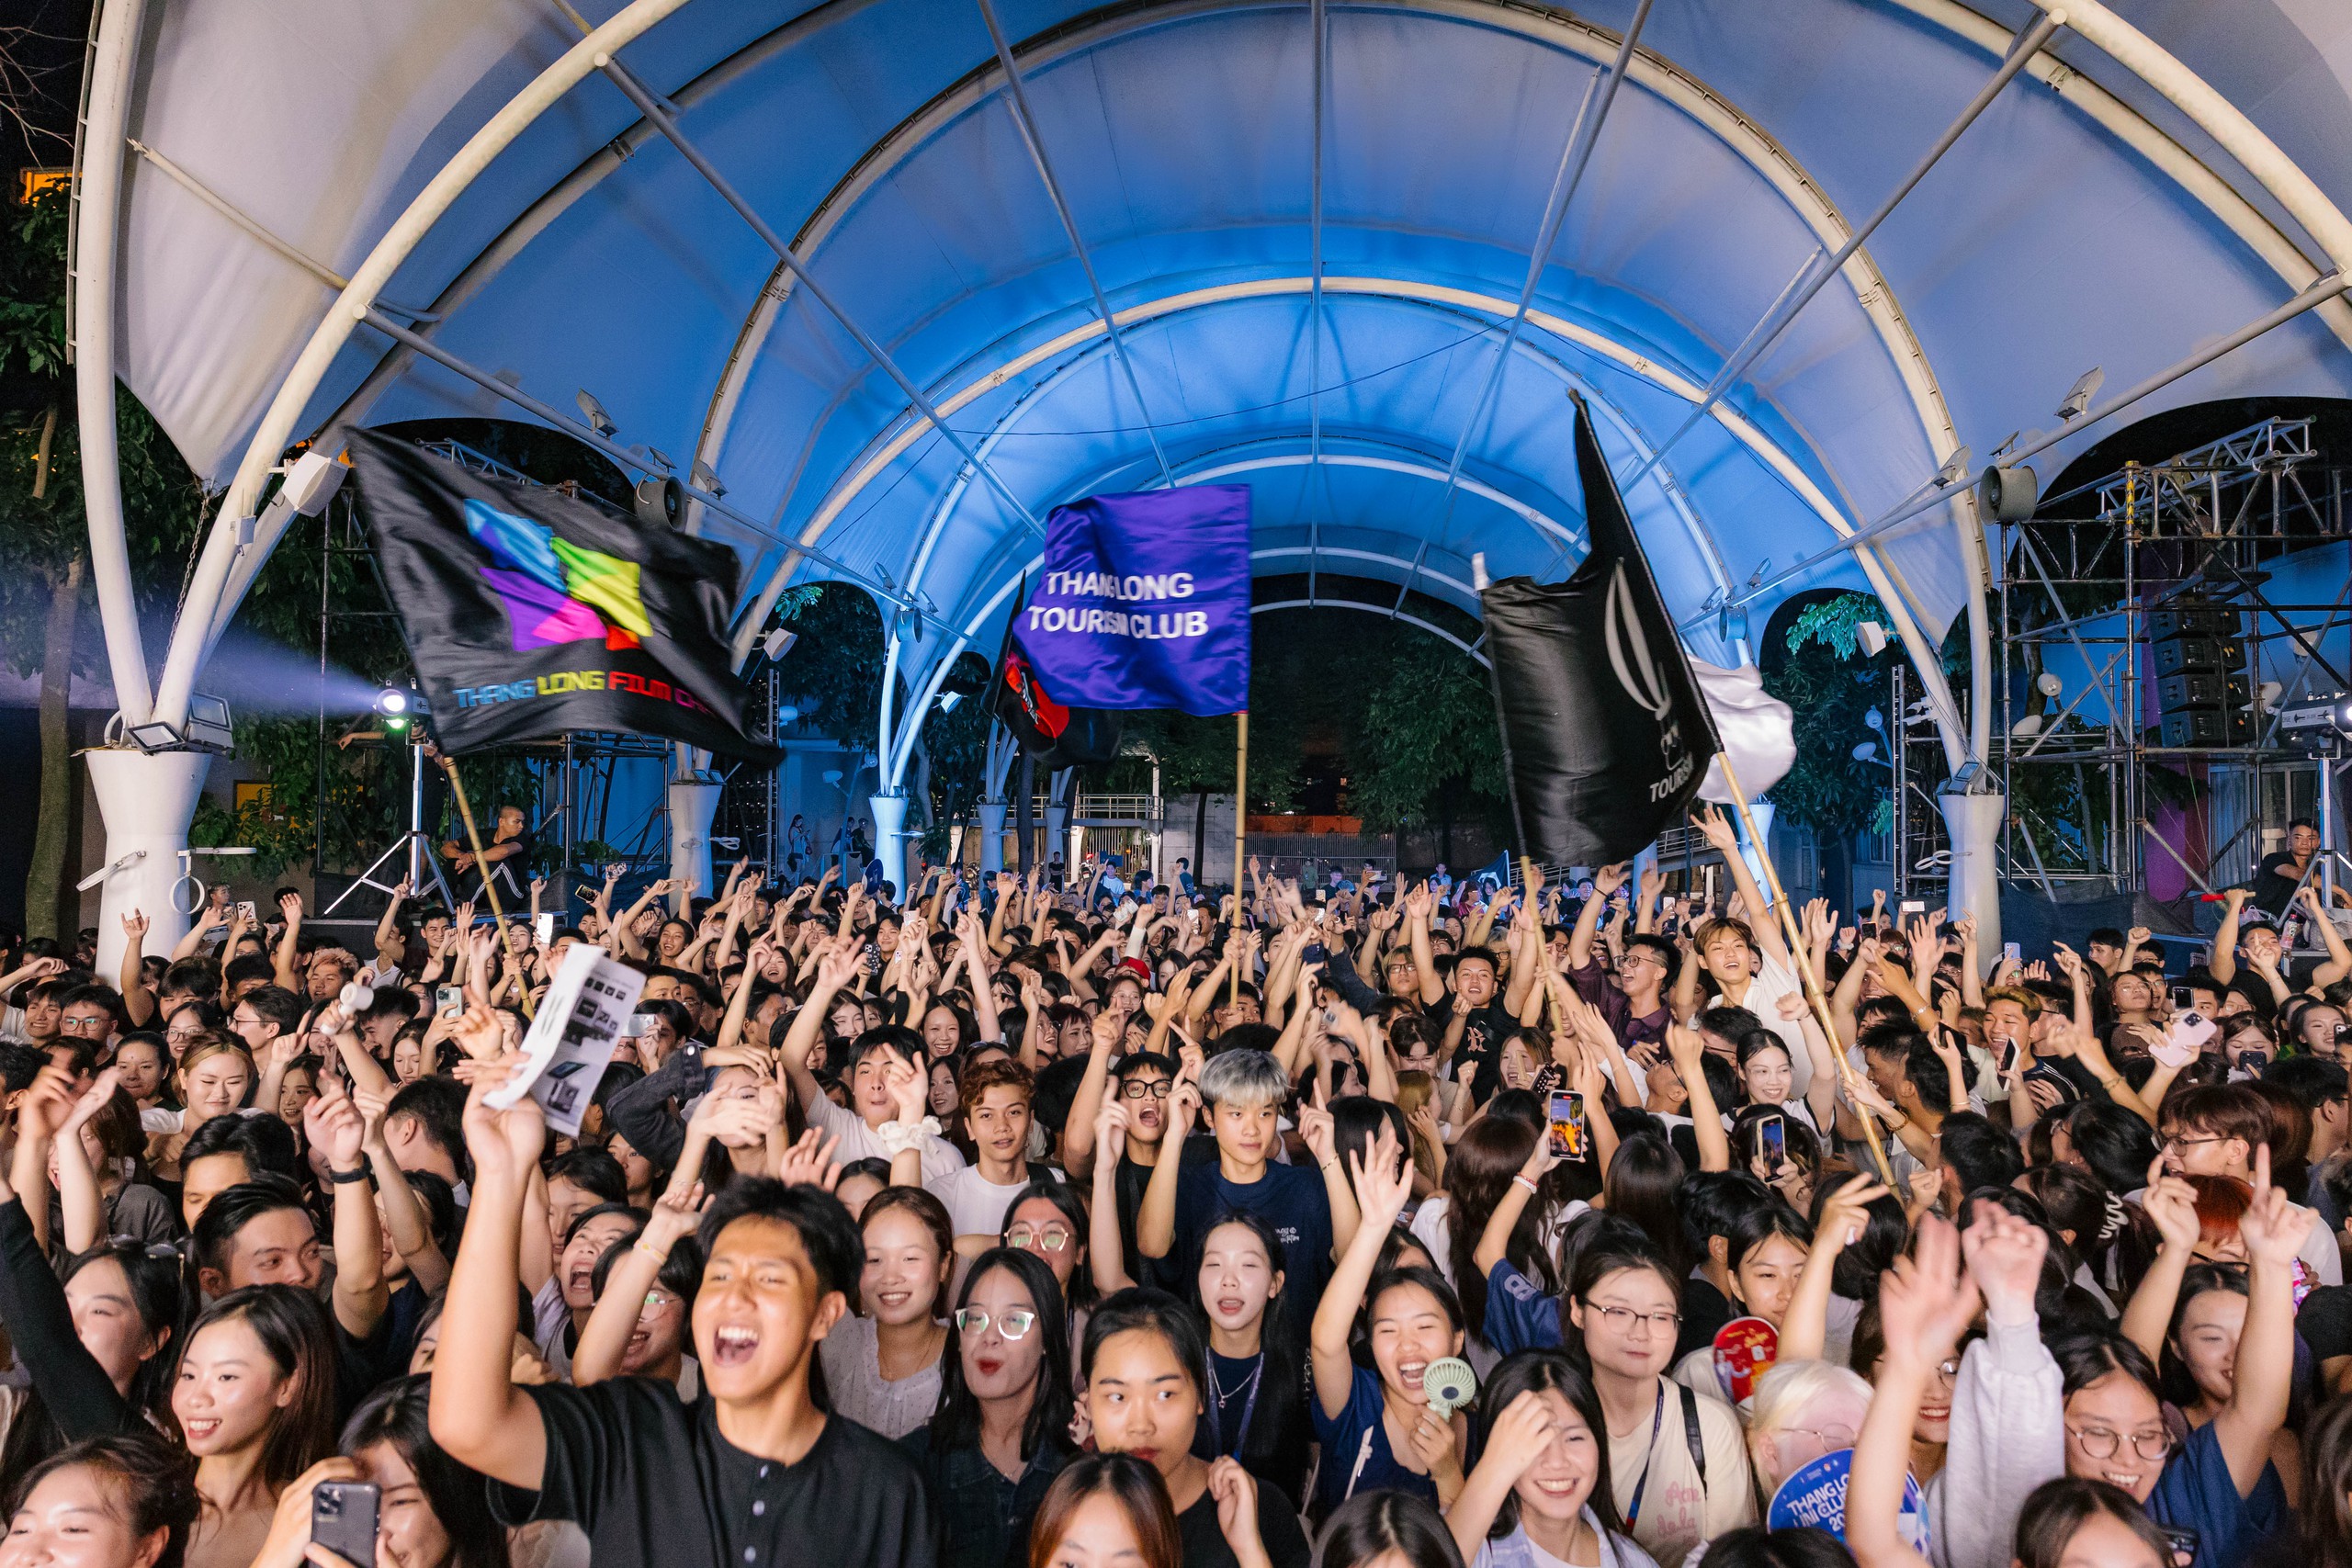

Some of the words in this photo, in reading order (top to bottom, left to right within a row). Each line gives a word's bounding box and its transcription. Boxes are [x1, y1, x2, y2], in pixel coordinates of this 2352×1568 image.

[1113, 571, 1194, 601] LONG
[1129, 611, 1209, 639] CLUB
[452, 679, 536, 708] THANG
[537, 670, 605, 695] LONG
[608, 671, 672, 702] FILM
[1786, 1482, 1837, 1516] THANG
[1833, 1473, 1849, 1494] LO
[1817, 1493, 1846, 1518] CLU
